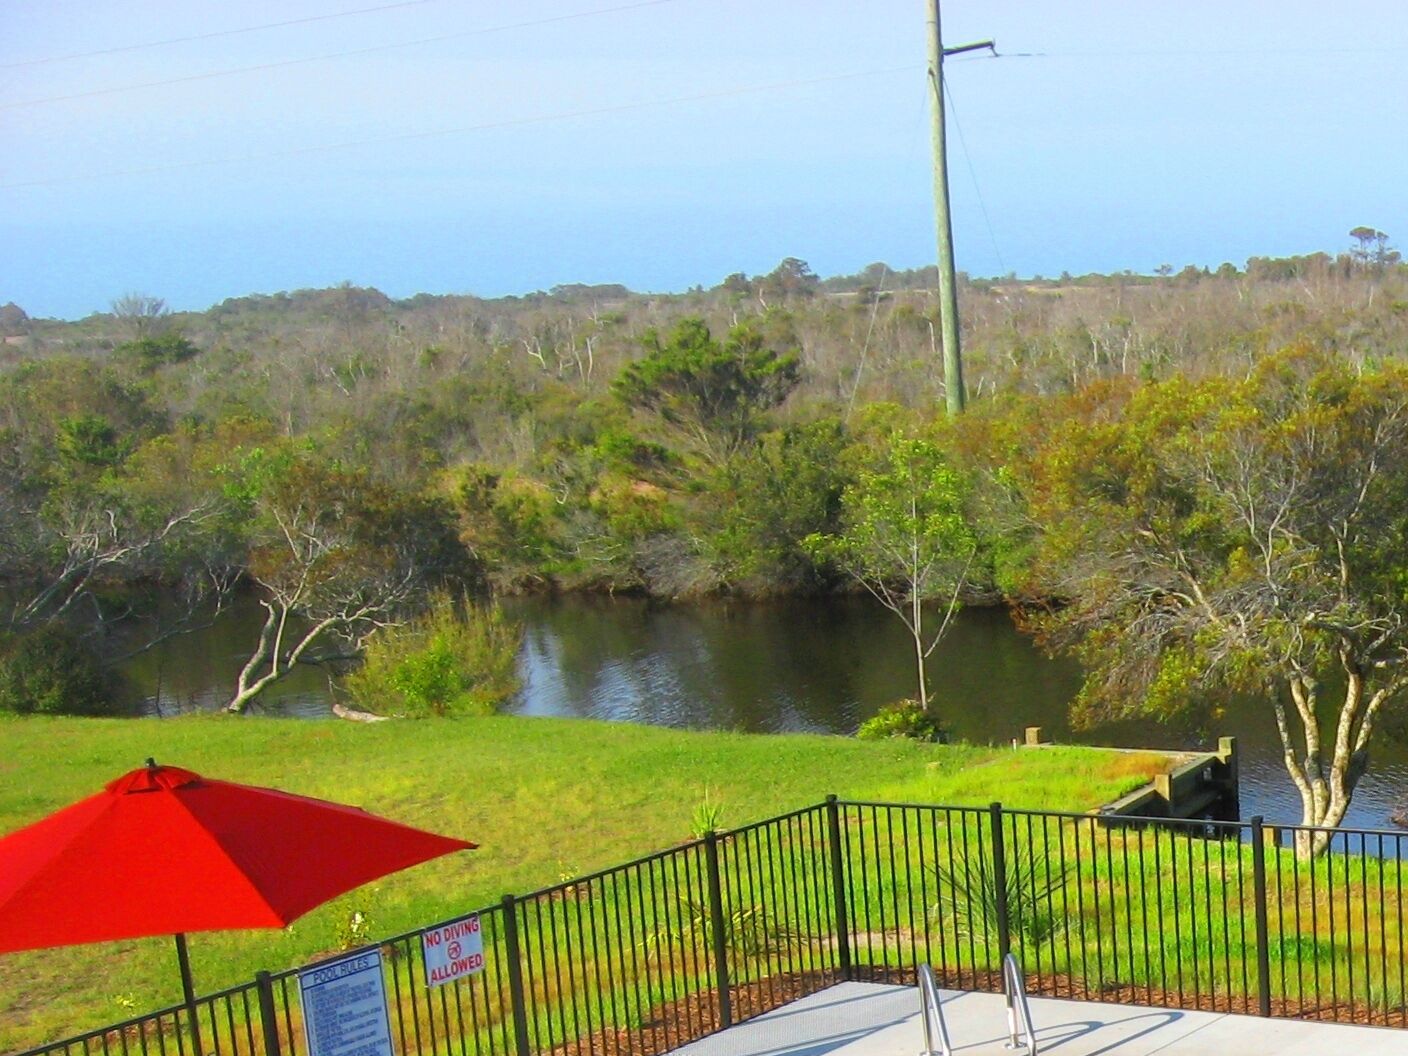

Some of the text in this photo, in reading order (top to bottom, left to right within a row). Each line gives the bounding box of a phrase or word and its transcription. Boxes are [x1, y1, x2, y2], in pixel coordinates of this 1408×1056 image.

[426, 919, 479, 948] NO DIVING
[313, 957, 369, 984] POOL RULES
[431, 953, 482, 982] ALLOWED
